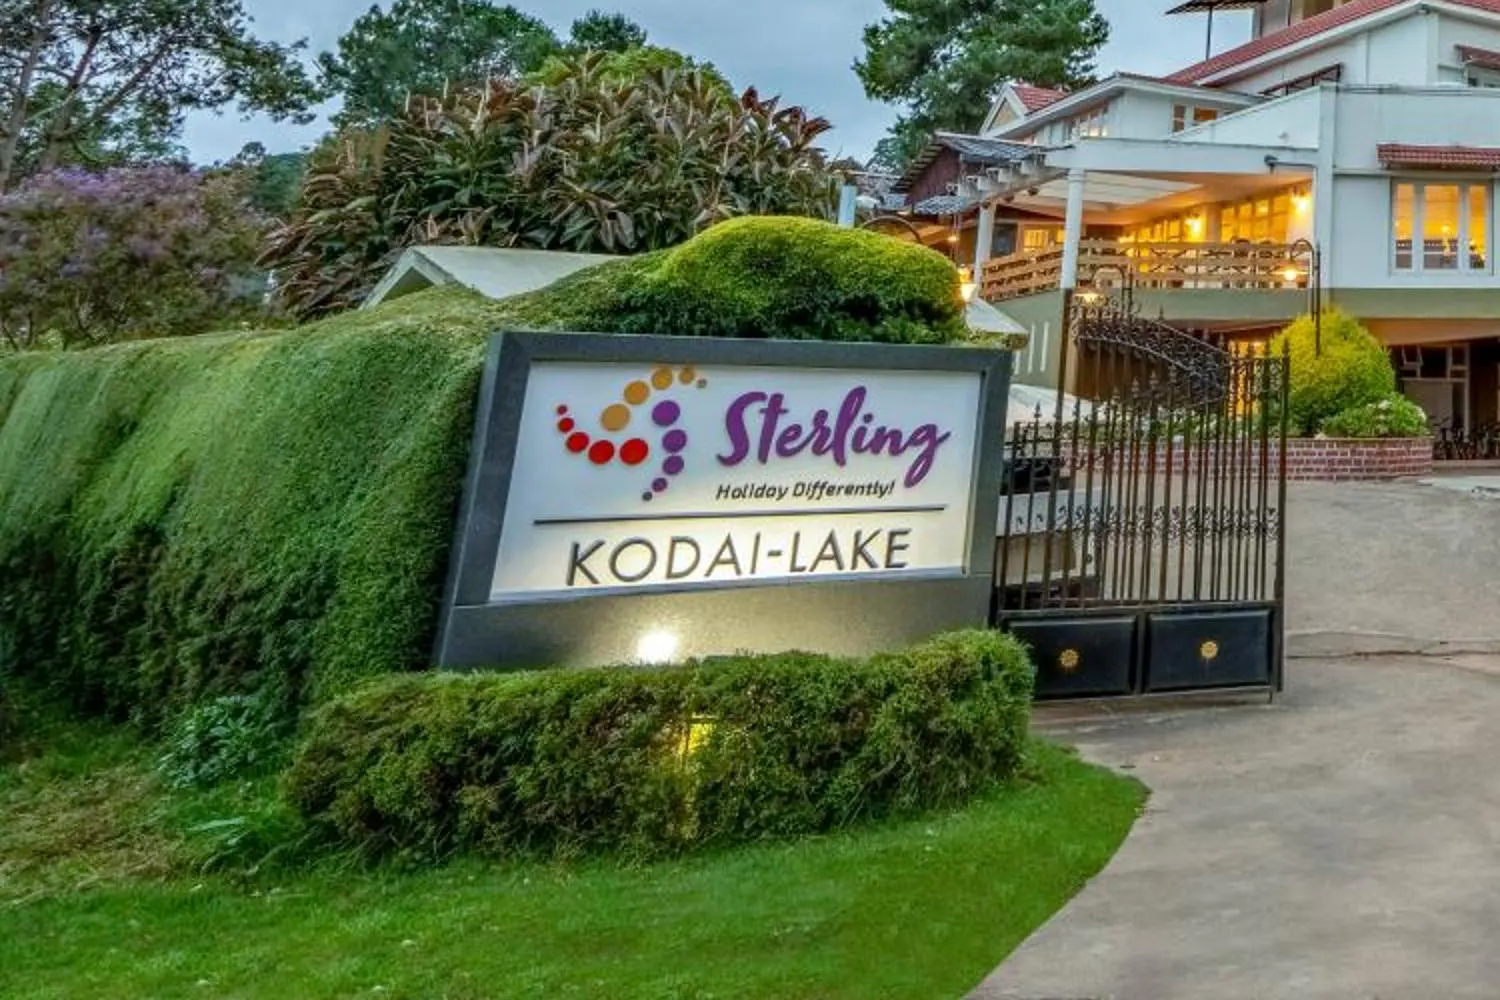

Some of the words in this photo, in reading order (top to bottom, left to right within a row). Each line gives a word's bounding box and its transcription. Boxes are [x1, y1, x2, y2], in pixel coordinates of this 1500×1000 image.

[716, 386, 951, 488] Sterling
[716, 482, 789, 501] Holiday
[792, 479, 896, 500] Differently!
[566, 528, 912, 586] KODAI-LAKE
